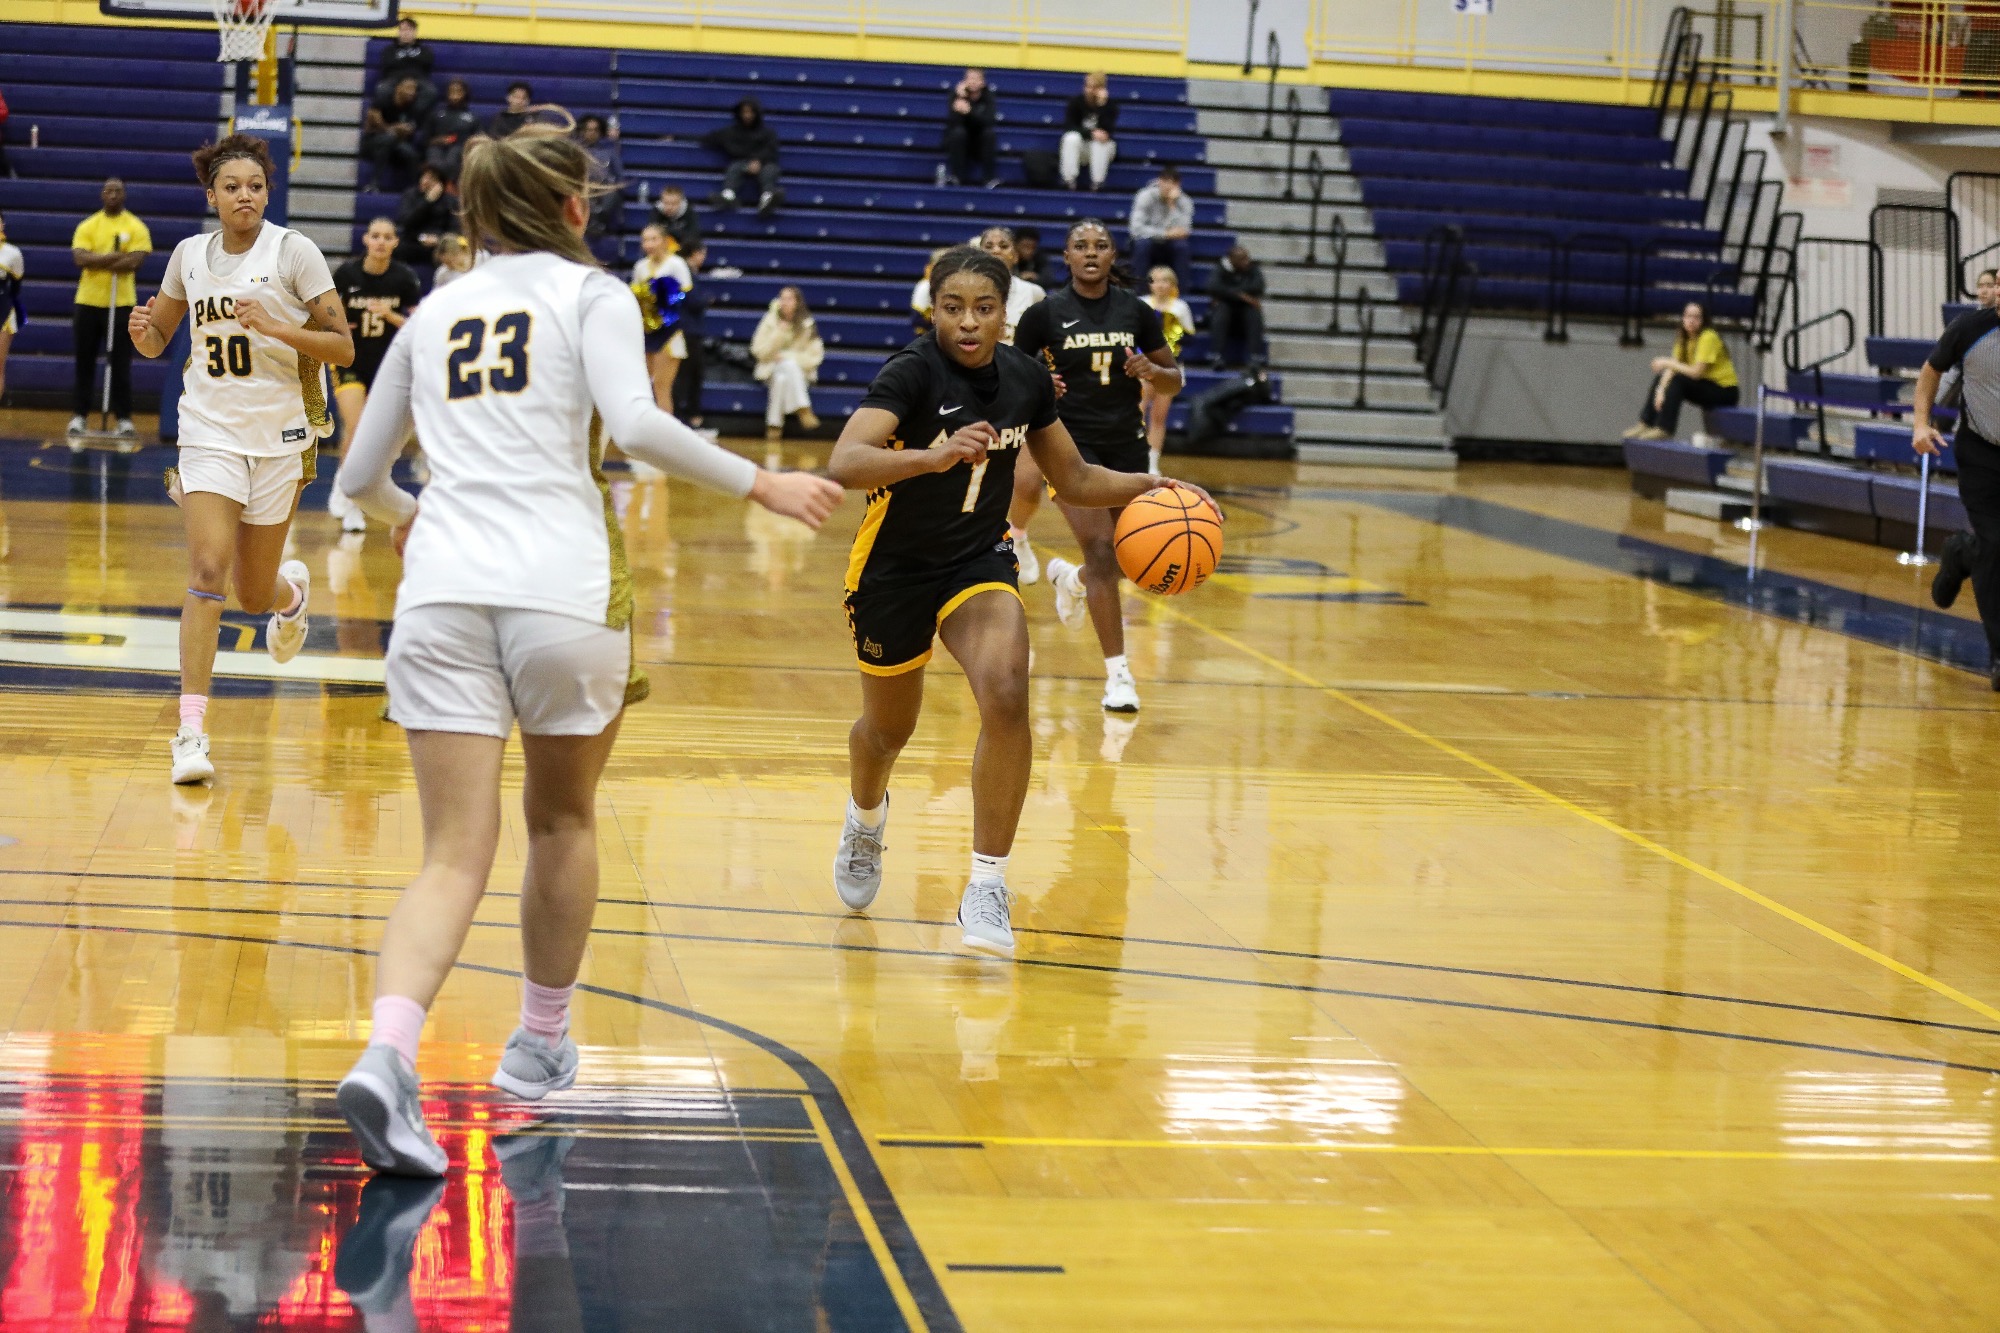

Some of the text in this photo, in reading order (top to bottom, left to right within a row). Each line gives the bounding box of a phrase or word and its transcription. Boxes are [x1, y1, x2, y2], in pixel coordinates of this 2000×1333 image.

[194, 296, 240, 328] PAC
[361, 310, 385, 337] 15
[205, 334, 252, 378] 30
[446, 310, 532, 401] 23
[1091, 350, 1113, 386] 4
[928, 423, 1030, 450] ALPH
[961, 458, 991, 513] 1
